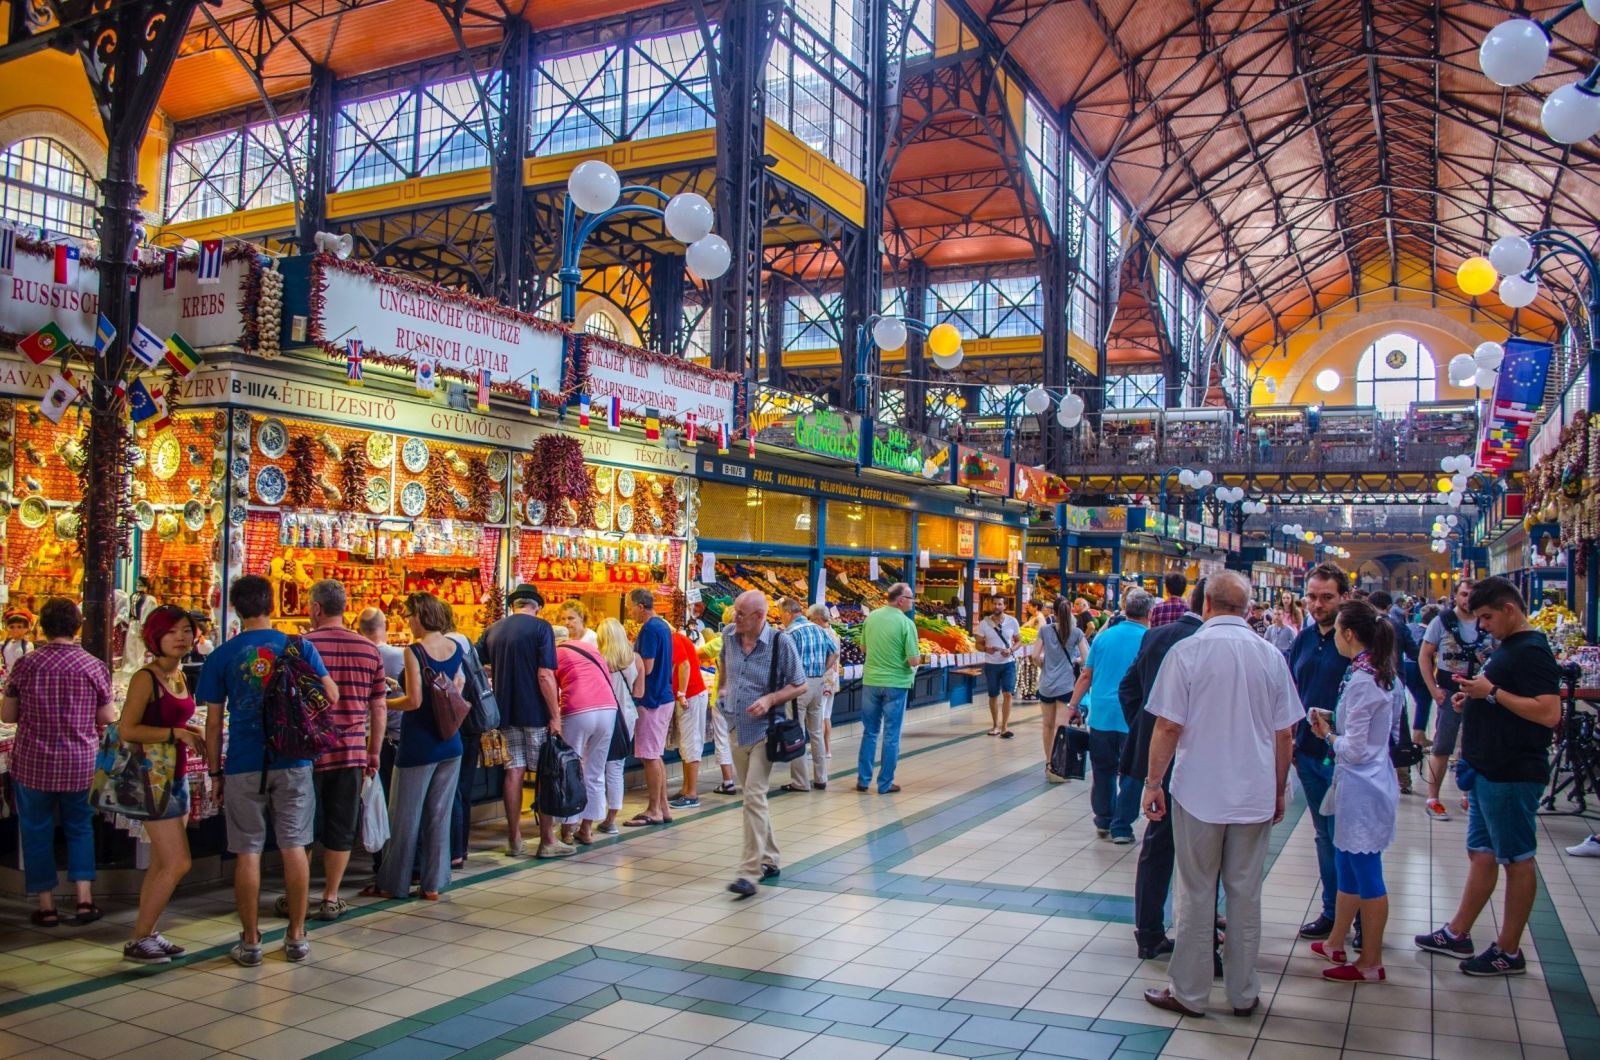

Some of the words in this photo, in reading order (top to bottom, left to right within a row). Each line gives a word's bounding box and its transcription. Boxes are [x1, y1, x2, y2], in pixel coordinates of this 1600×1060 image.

[182, 293, 225, 318] KREBS
[380, 288, 463, 328] UNGARISCHE
[396, 328, 460, 362] RUSSISCH
[465, 345, 508, 373] CAVIAR
[629, 358, 649, 378] WEIN
[664, 367, 711, 395] UNGARISCHER
[698, 402, 724, 421] SAFRAN
[431, 413, 512, 440] GYÜMÖLCS
[635, 445, 677, 467] TÉSZTÁK
